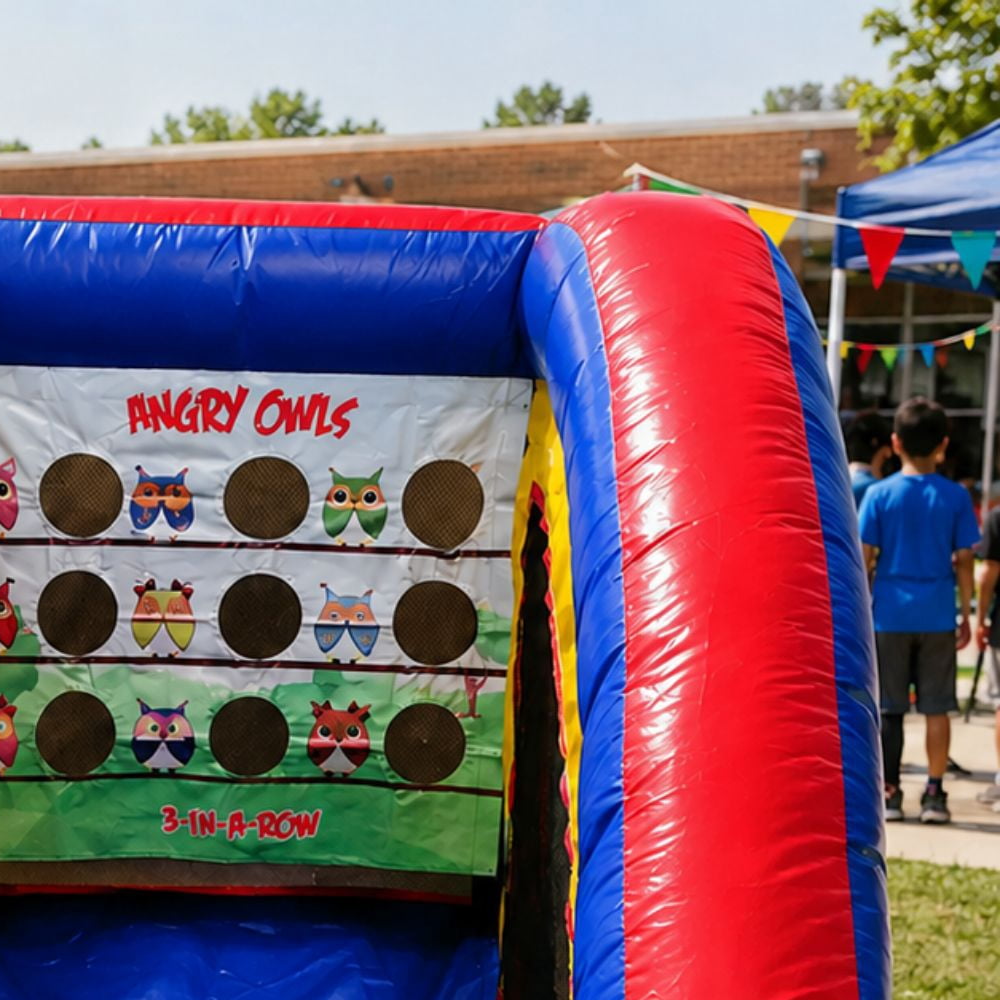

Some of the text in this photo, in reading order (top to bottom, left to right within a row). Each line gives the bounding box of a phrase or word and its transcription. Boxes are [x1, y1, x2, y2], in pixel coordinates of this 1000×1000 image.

[127, 384, 359, 440] ANGRY OWLS
[160, 805, 322, 841] 3-IN-A-ROW
